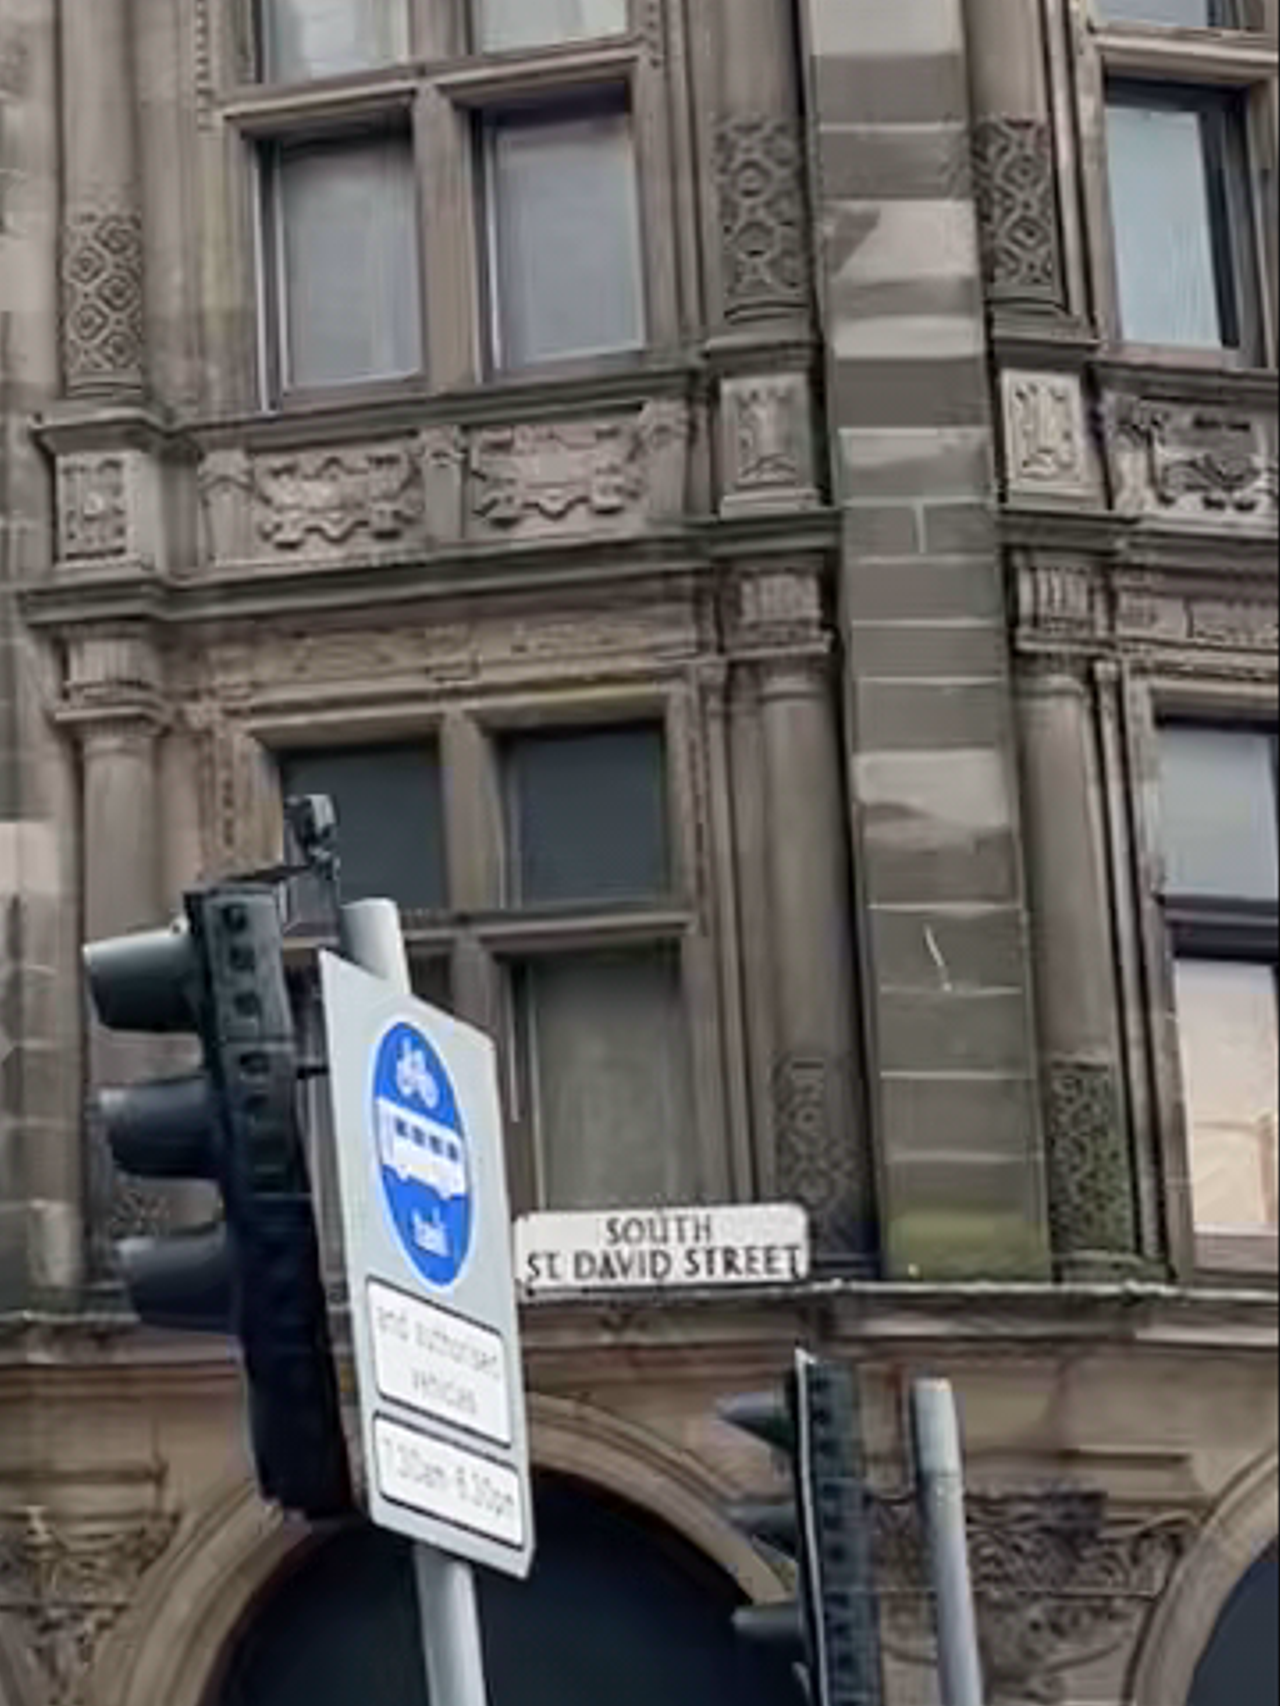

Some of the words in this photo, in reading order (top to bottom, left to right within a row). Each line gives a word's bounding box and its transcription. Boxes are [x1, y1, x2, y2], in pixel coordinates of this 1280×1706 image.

[605, 1215, 711, 1246] SOUTH
[573, 1248, 671, 1280] DAVID
[684, 1245, 801, 1278] STREET
